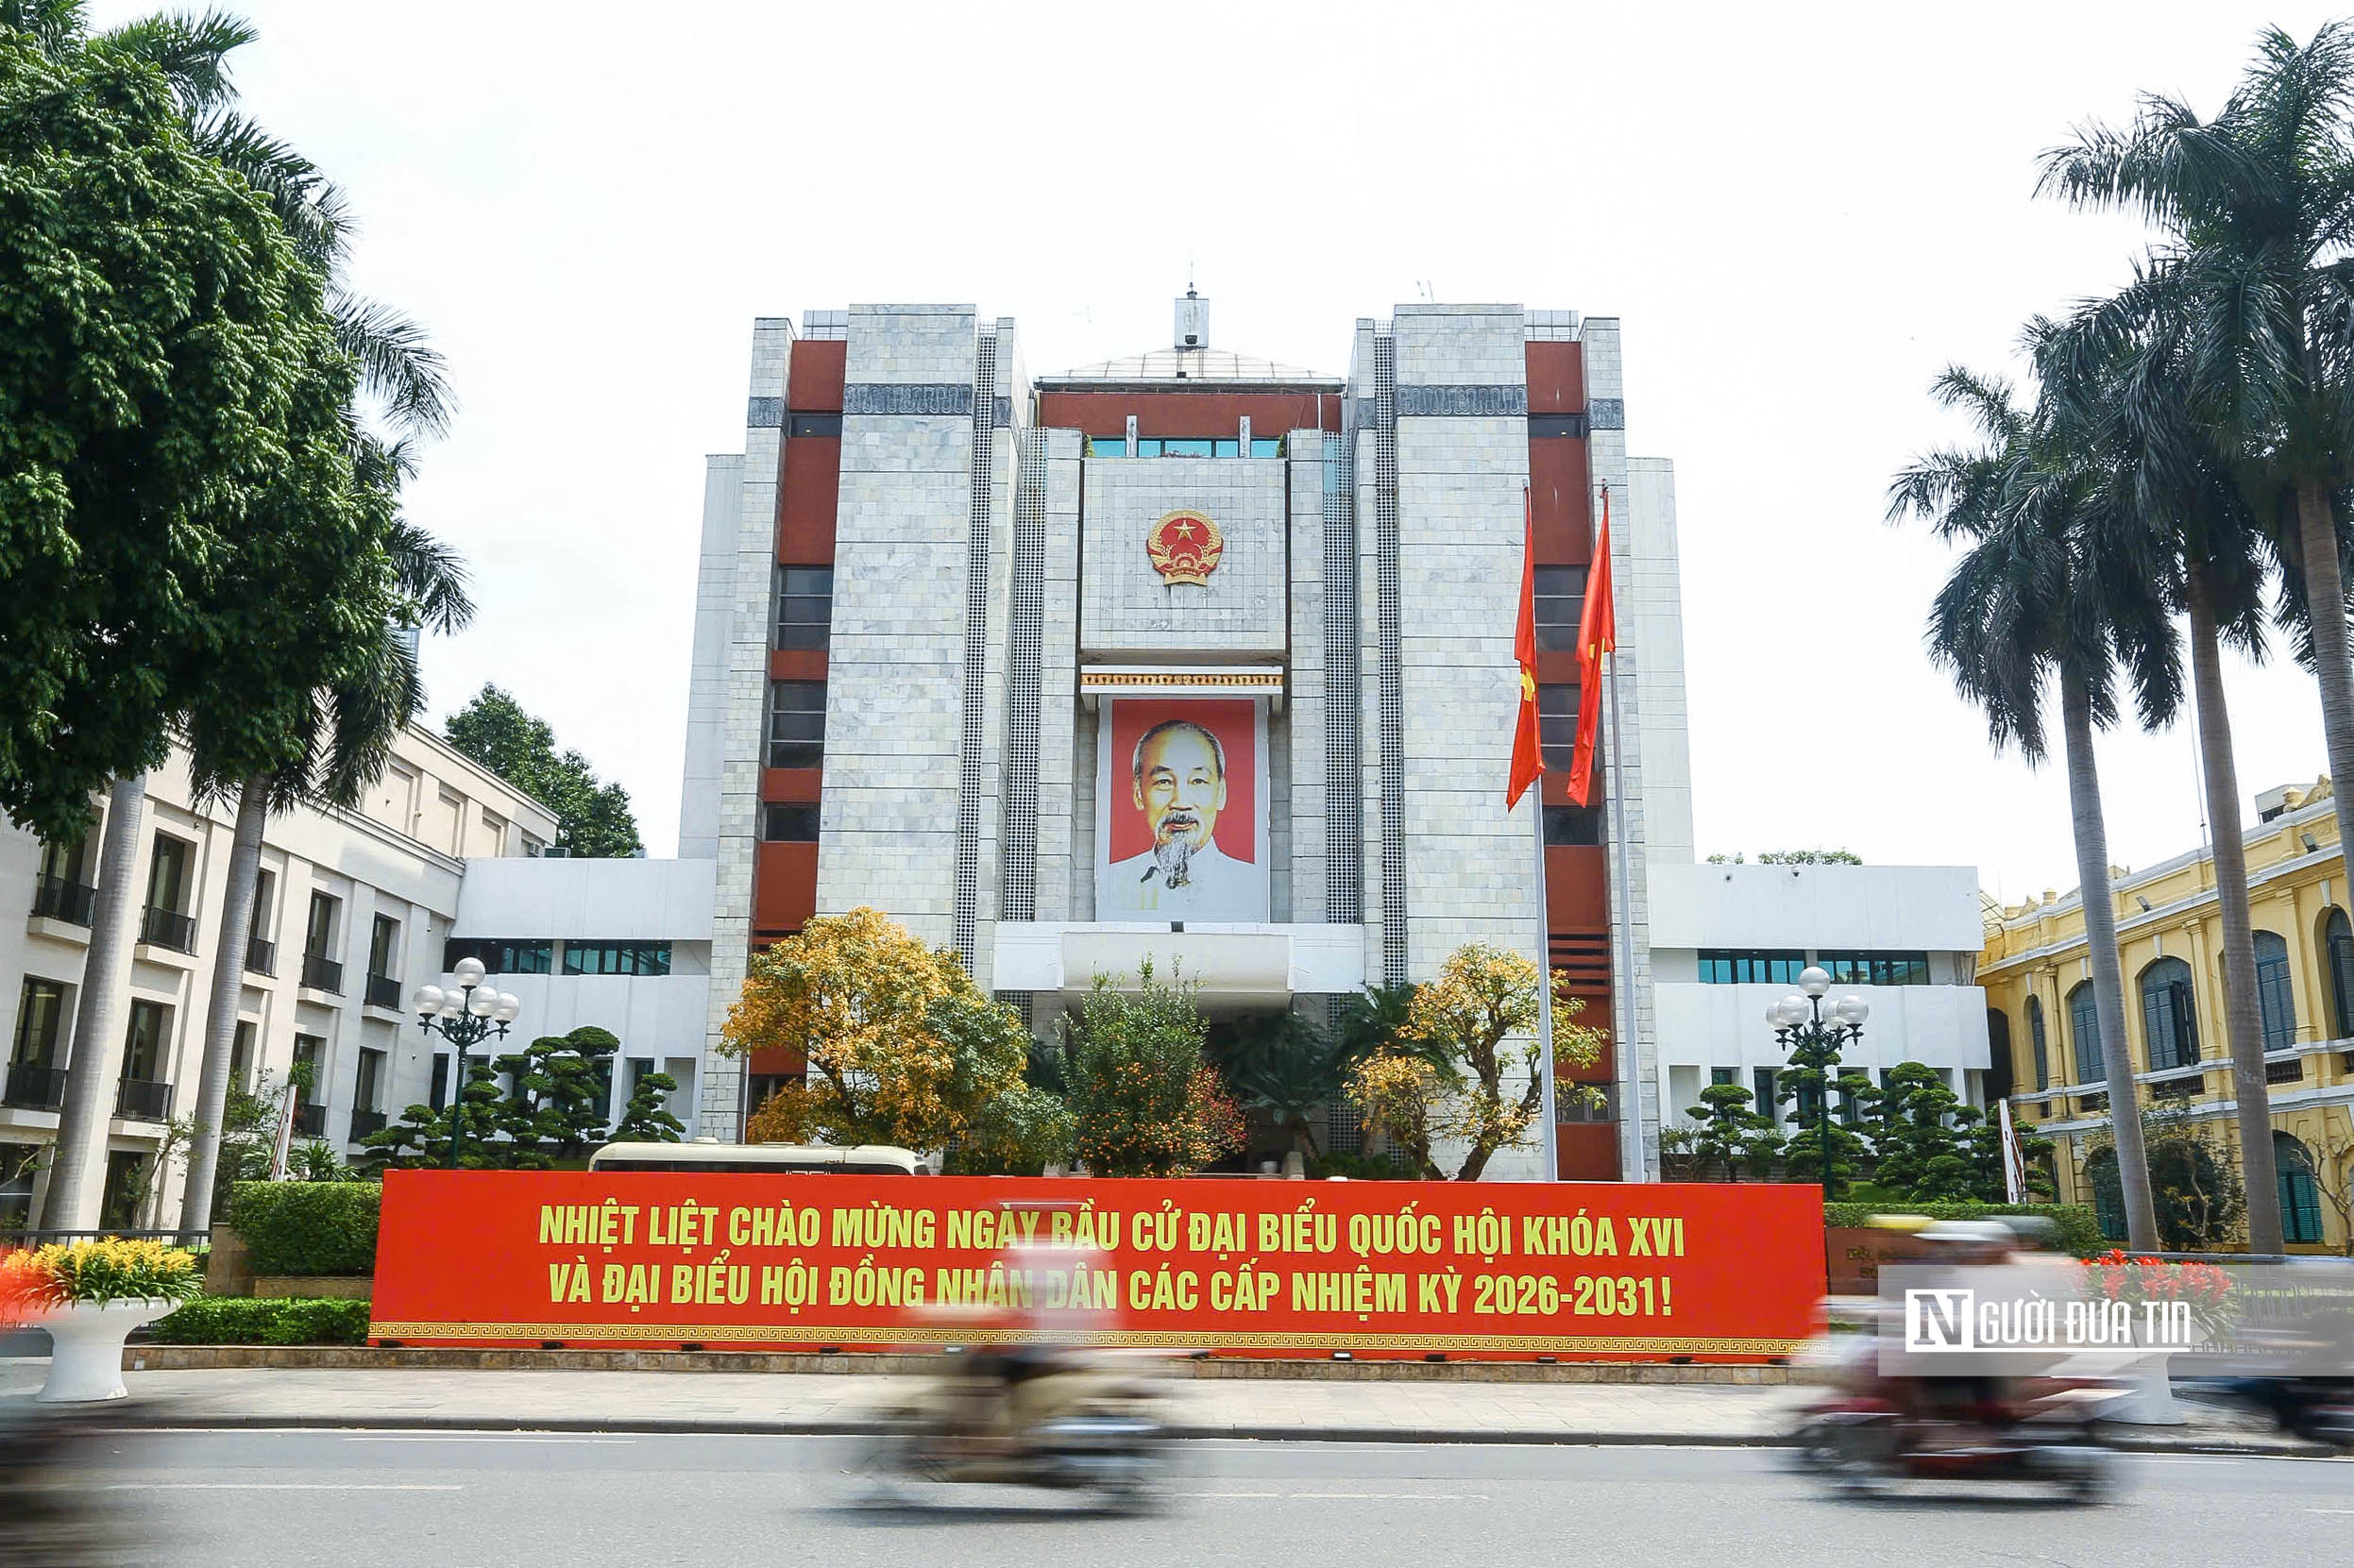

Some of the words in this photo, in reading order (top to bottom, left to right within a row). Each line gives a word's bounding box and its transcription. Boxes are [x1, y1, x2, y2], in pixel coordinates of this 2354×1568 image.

[539, 1197, 640, 1254] NHIỆT
[648, 1198, 720, 1255] LIỆT
[728, 1199, 820, 1247] CHÀO
[831, 1200, 936, 1249] MỪNG
[946, 1202, 1041, 1250] NGÀY
[1051, 1198, 1120, 1251] BẦU
[1131, 1198, 1182, 1252] CỬ
[1187, 1212, 1246, 1261] ĐẠI
[1258, 1197, 1337, 1254] BIỂU
[1348, 1200, 1442, 1258] QUỐC
[1453, 1206, 1512, 1264] HỘI
[1522, 1207, 1618, 1256] KHÓA
[1627, 1217, 1685, 1257] XVI
[549, 1255, 592, 1303] VÀ
[601, 1263, 661, 1313] ĐẠI
[670, 1248, 751, 1306] BIỂU
[760, 1257, 819, 1315] HỘI
[828, 1253, 924, 1307] ĐỒNG
[936, 1260, 1034, 1309] NHÂN
[1045, 1261, 1118, 1310] DÂN
[1129, 1261, 1199, 1311] CÁC
[1211, 1256, 1280, 1312] CẤP
[1292, 1264, 1407, 1322] NHIỆM
[1418, 1265, 1464, 1314] KỲ
